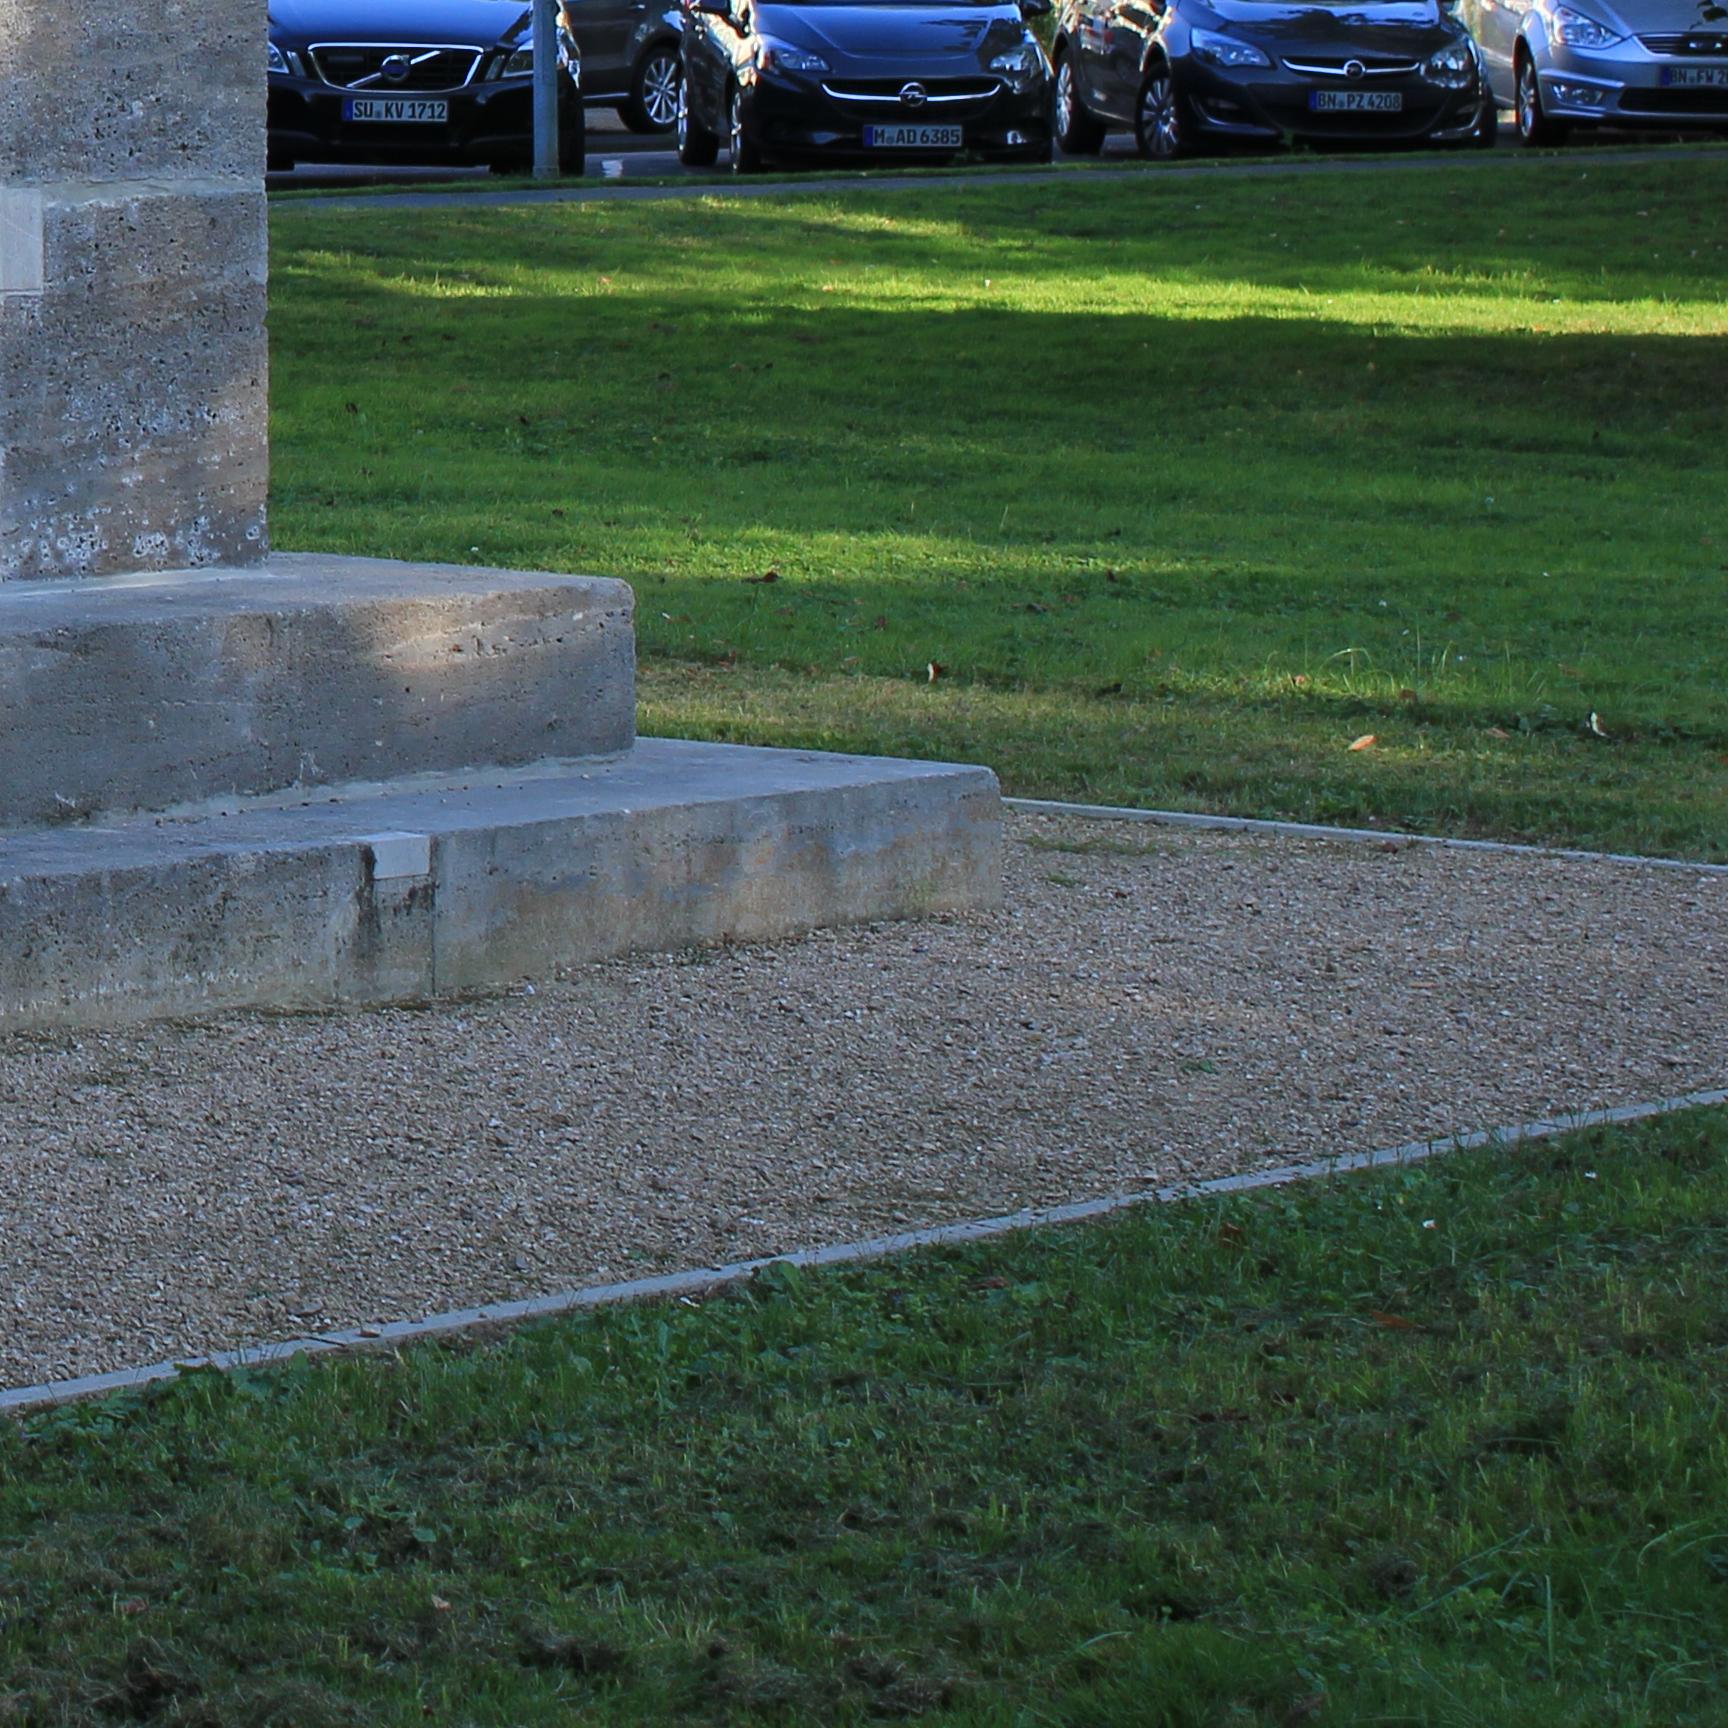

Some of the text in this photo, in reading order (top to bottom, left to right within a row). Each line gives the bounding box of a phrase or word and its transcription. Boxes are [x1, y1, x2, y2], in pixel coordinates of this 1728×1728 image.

[1318, 93, 1401, 109] BN PZ 4208
[354, 101, 446, 119] SU KV 1712
[874, 129, 961, 144] M AD 6385
